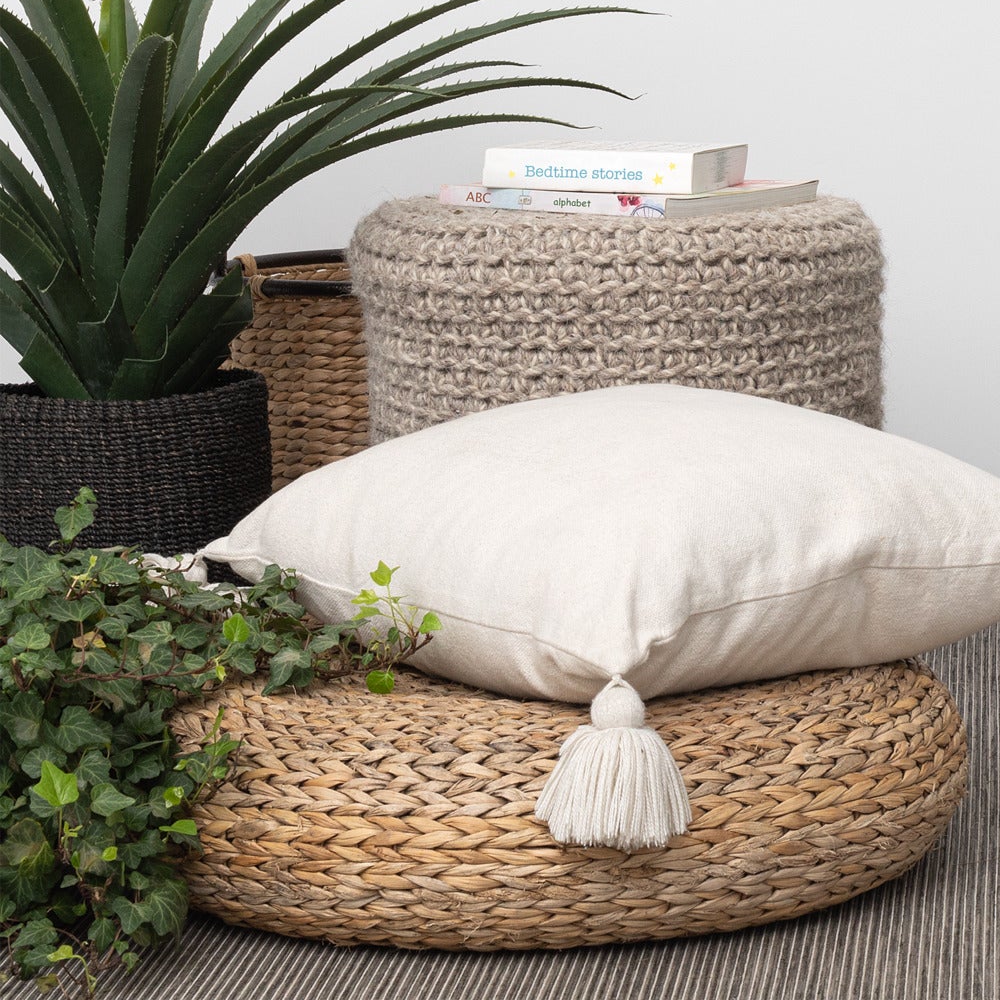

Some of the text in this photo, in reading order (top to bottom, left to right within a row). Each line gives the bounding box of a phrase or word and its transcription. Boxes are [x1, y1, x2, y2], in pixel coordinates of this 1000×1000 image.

[525, 165, 643, 181] Bedtime stories
[465, 191, 491, 204] ABC
[553, 197, 592, 208] alphabet
